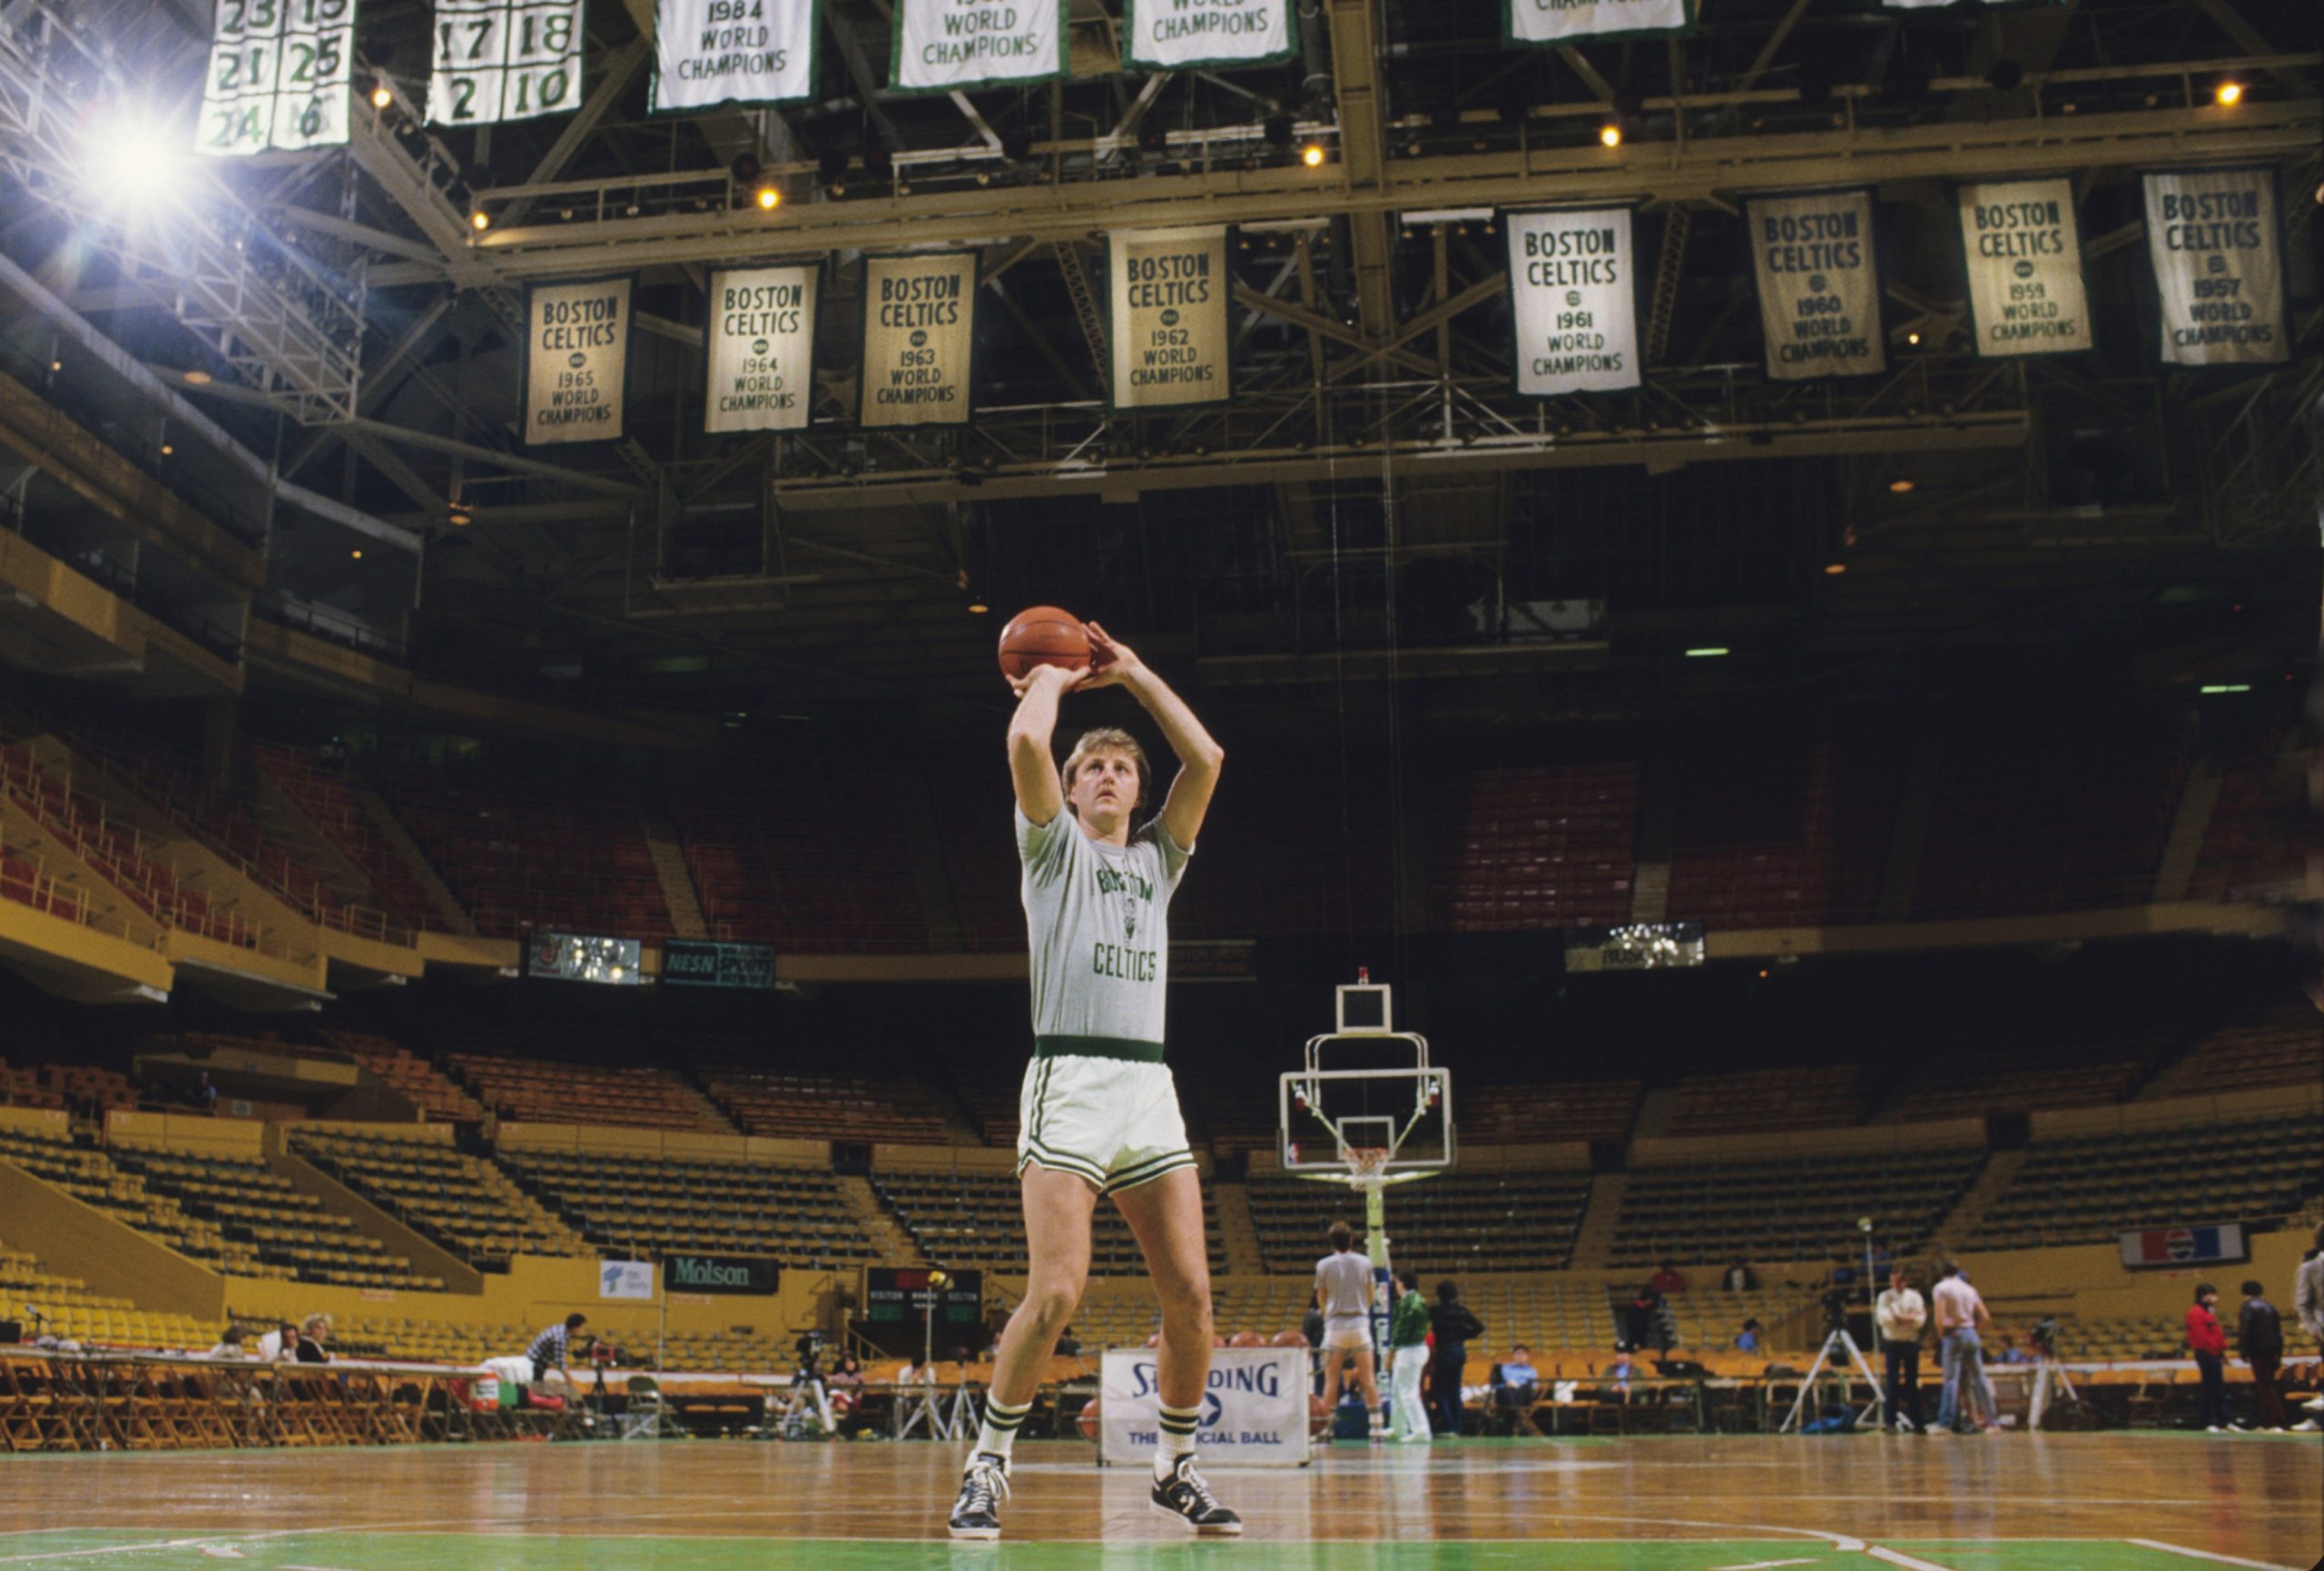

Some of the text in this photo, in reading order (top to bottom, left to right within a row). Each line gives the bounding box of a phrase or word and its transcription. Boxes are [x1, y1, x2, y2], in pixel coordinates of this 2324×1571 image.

[708, 1, 763, 23] 1984
[944, 8, 1017, 36] WORLD
[1153, 7, 1269, 43] CHAMPIONS
[440, 15, 573, 60] 17 18
[702, 25, 769, 51] WORLD
[922, 33, 1038, 64] CHAMPIONS
[218, 35, 342, 91] 21 25
[678, 49, 787, 80] CHAMPIONS
[450, 69, 568, 120] 2 10
[208, 104, 263, 147] 24
[1974, 201, 2060, 230] BOSTON
[2162, 191, 2258, 221] BOSTON
[1763, 211, 1857, 243] BOSTON
[2165, 222, 2260, 252] CELTICS
[1524, 228, 1615, 258] BOSTON
[1978, 230, 2063, 258] CELTICS
[1127, 252, 1209, 282] BOSTON
[1767, 242, 1861, 272] CELTICS
[1527, 259, 1617, 287] CELTICS
[724, 284, 803, 311] BOSTON
[881, 274, 960, 301] BOSTON
[1128, 279, 1209, 308] CELTICS
[543, 296, 618, 325] BOSTON
[724, 311, 800, 336] CELTICS
[880, 301, 959, 328] CELTICS
[1557, 311, 1593, 330] 1961
[2003, 301, 2060, 321] WORLD
[2190, 301, 2252, 322] WORLD
[543, 321, 615, 351] CELTICS
[1151, 329, 1189, 346] 1962
[1794, 316, 1851, 340] WORLD
[1990, 320, 2076, 341] CHAMPIONS
[2174, 323, 2273, 347] CHAMPIONS
[1547, 333, 1605, 352] WORLD
[1780, 338, 1870, 363] CHAMPIONS
[743, 358, 778, 374] 1964
[901, 349, 935, 367] 1963
[1143, 348, 1196, 366] WORLD
[1532, 352, 1623, 376] CHAMPIONS
[558, 370, 595, 389] 1965
[734, 377, 783, 393] WORLD
[891, 368, 941, 385] WORLD
[1129, 364, 1213, 386] CHAMPIONS
[552, 388, 599, 407] WORLD
[720, 393, 795, 412] CHAMPIONS
[877, 386, 955, 405] CHAMPIONS
[537, 404, 611, 426] CHAMPIONS
[667, 953, 715, 973] NESN
[1093, 943, 1157, 982] CELTICS
[674, 1258, 749, 1286] Molson
[1133, 1362, 1277, 1398] SDING
[1128, 1432, 1158, 1445] THE
[1240, 1431, 1283, 1445] BALL
